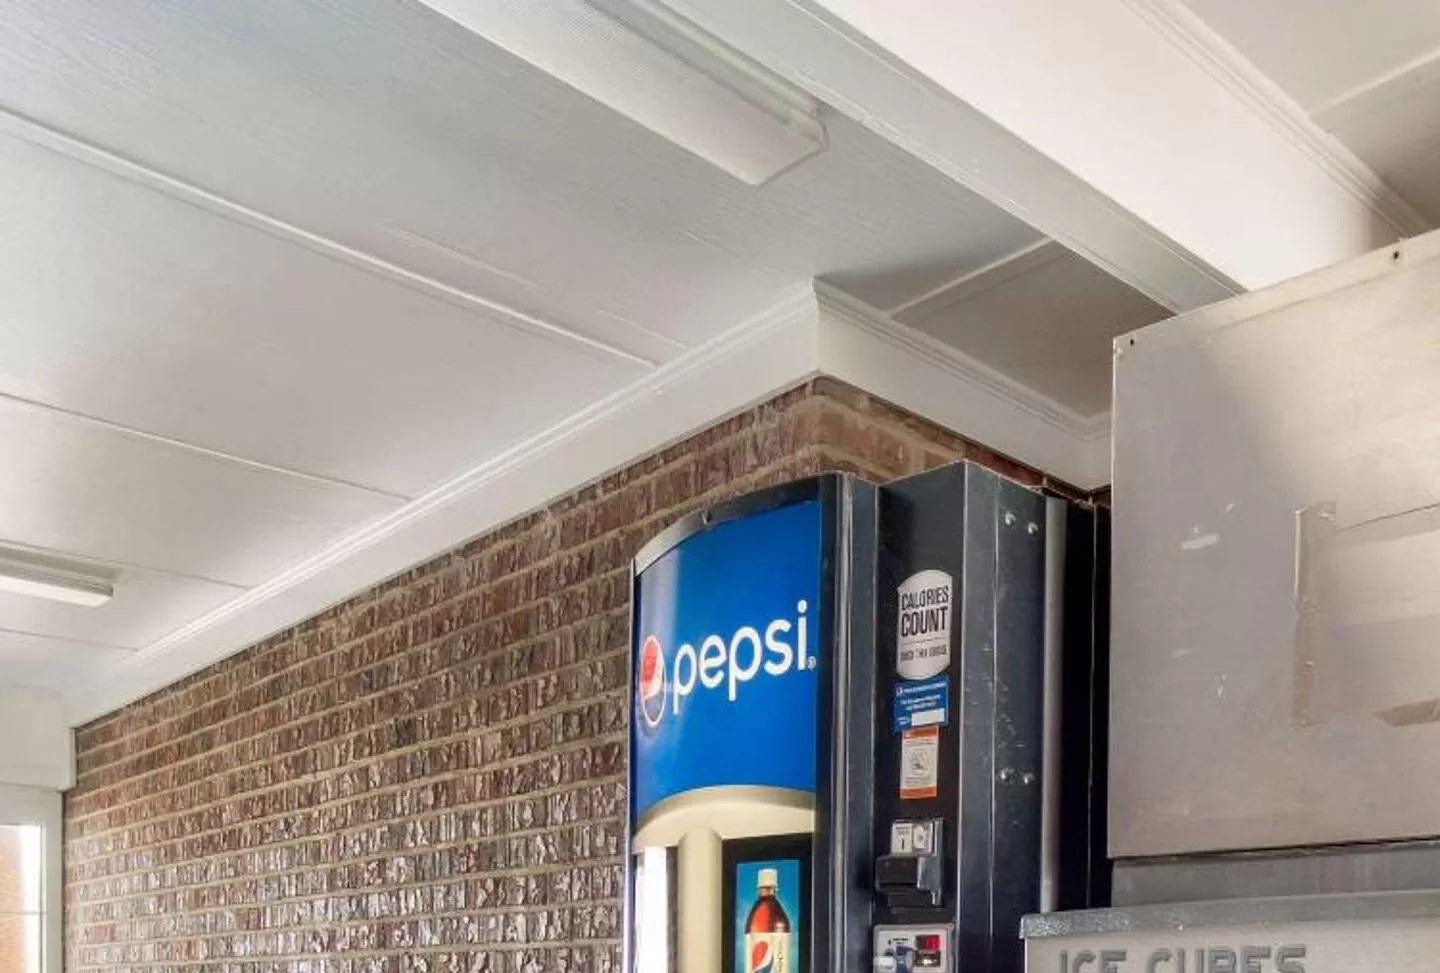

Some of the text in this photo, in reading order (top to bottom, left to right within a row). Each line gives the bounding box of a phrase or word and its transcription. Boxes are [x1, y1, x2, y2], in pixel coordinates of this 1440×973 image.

[901, 584, 949, 611] CALORIES
[901, 606, 949, 638] COUNT
[673, 600, 807, 715] pepsi
